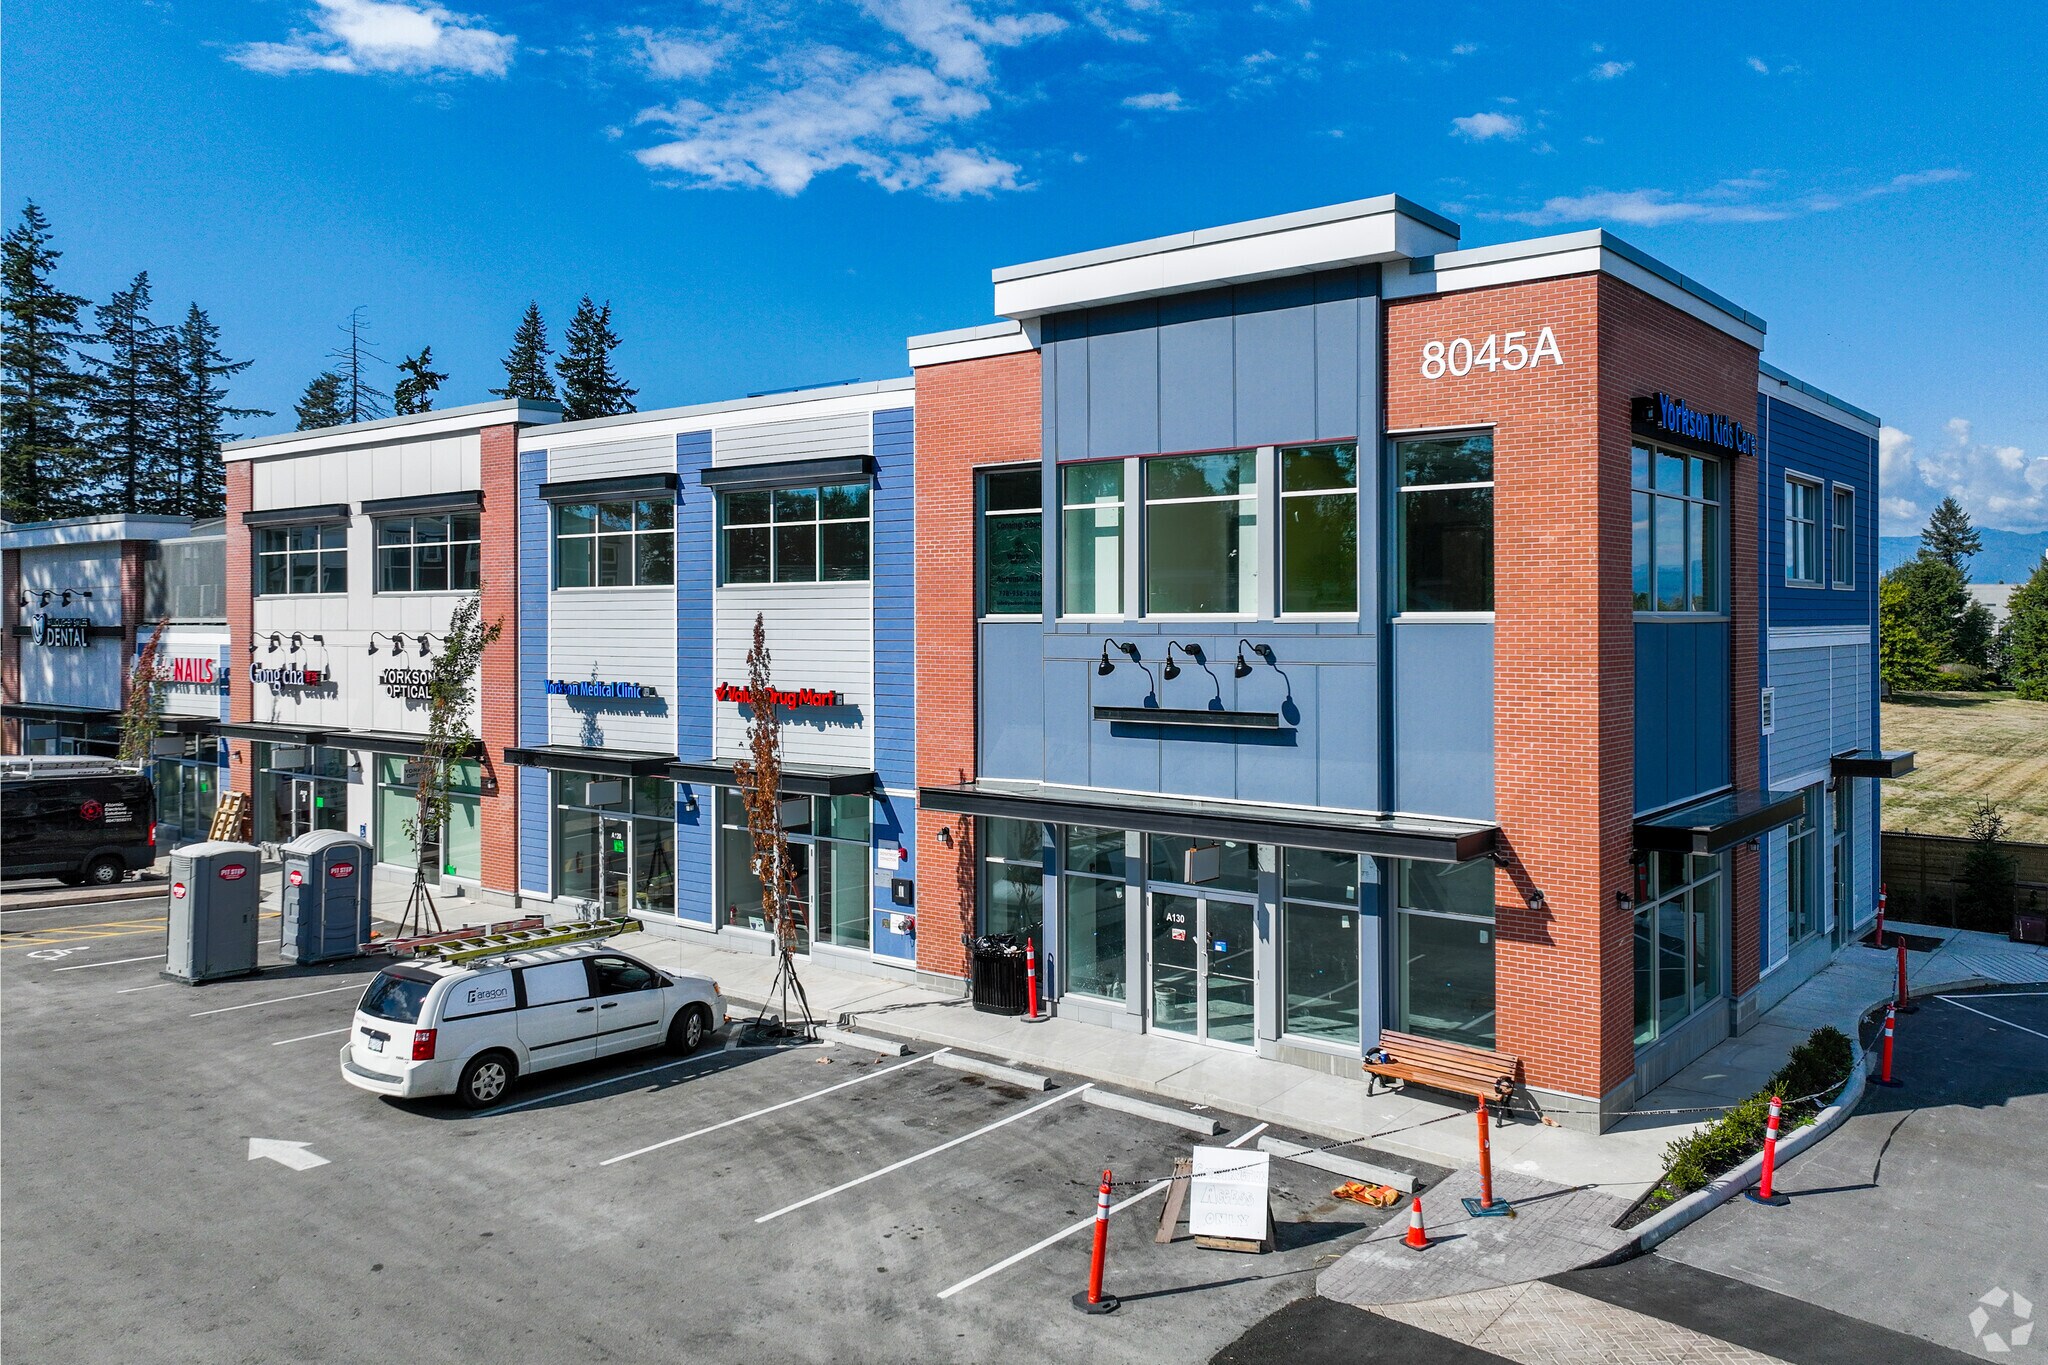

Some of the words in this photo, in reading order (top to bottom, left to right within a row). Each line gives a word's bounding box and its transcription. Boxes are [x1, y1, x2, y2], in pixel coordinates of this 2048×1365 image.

[1421, 326, 1564, 380] 8045A
[1659, 392, 1711, 442] Yorkson
[1712, 412, 1734, 449] Kids
[1735, 421, 1757, 457] Care
[47, 628, 87, 647] DENTAL
[174, 657, 213, 683] NAILS
[249, 662, 282, 691] Gong
[282, 663, 305, 685] cha
[383, 670, 436, 685] YORKSON
[386, 684, 433, 699] OPTICAL
[544, 680, 579, 695] Yorkson
[580, 681, 615, 697] Medical
[616, 682, 641, 698] Clinic
[799, 688, 834, 707] Mart
[1166, 912, 1185, 924] A130
